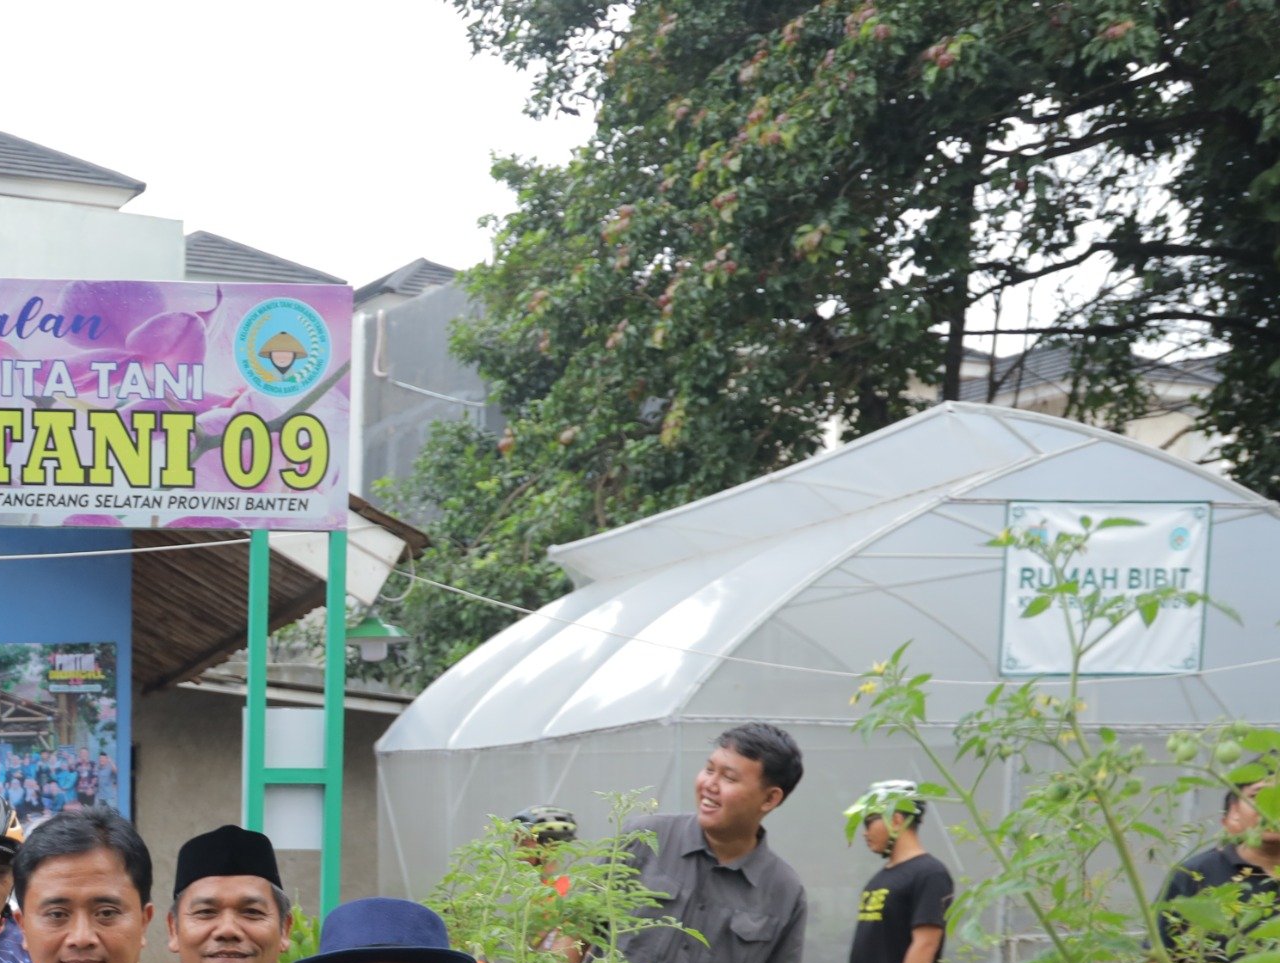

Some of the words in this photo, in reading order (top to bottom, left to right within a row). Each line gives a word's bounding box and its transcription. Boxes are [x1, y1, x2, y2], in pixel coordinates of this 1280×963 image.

[91, 361, 204, 400] TANI
[221, 411, 330, 490] 09
[95, 494, 162, 509] SELATAN
[167, 495, 239, 510] PROVINSI
[245, 497, 310, 512] BANTEN
[1127, 567, 1191, 590] BIBIT
